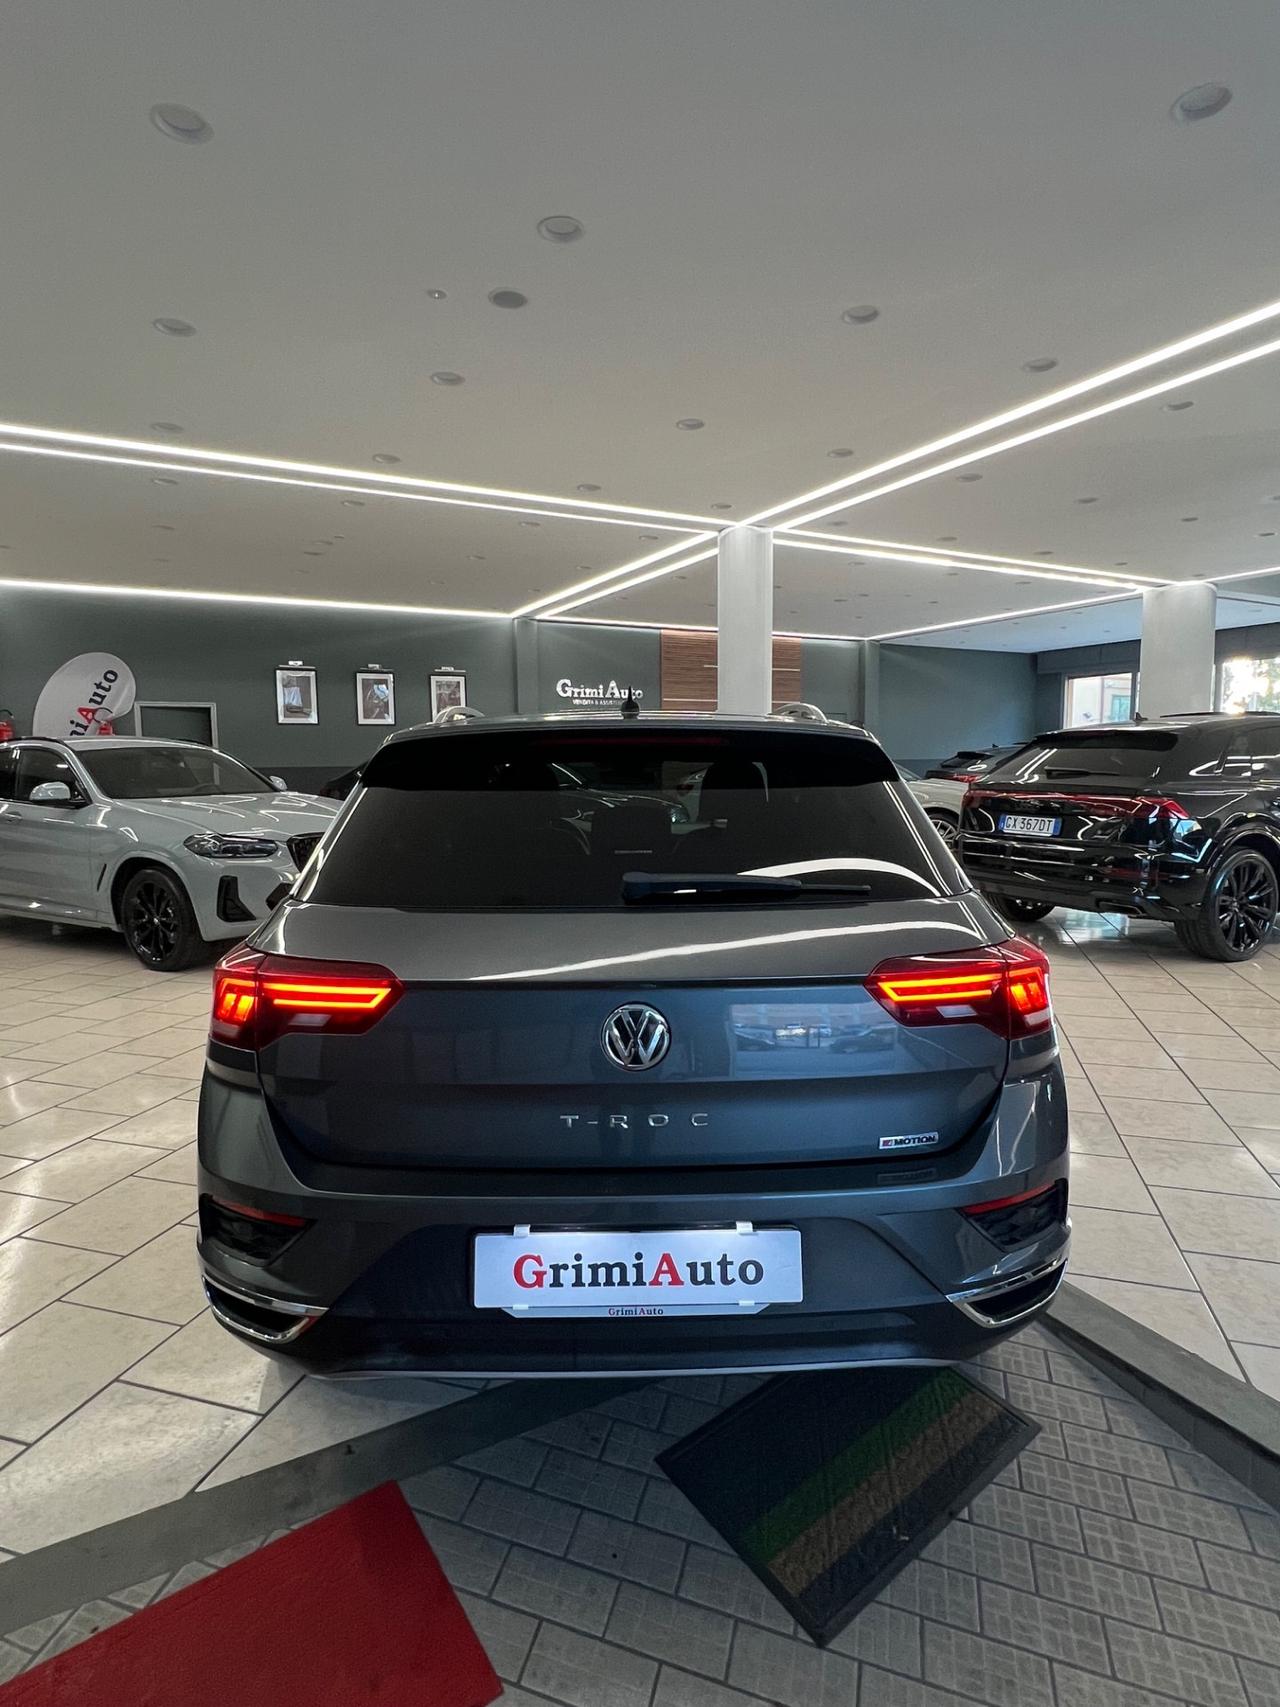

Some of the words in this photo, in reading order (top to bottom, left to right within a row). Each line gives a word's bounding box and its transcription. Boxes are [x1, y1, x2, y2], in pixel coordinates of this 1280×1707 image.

[1020, 817, 1053, 832] 367DT
[560, 1113, 708, 1129] T-ROC
[513, 1252, 764, 1288] GrimiAuto
[608, 1307, 664, 1316] GrimiAuto
